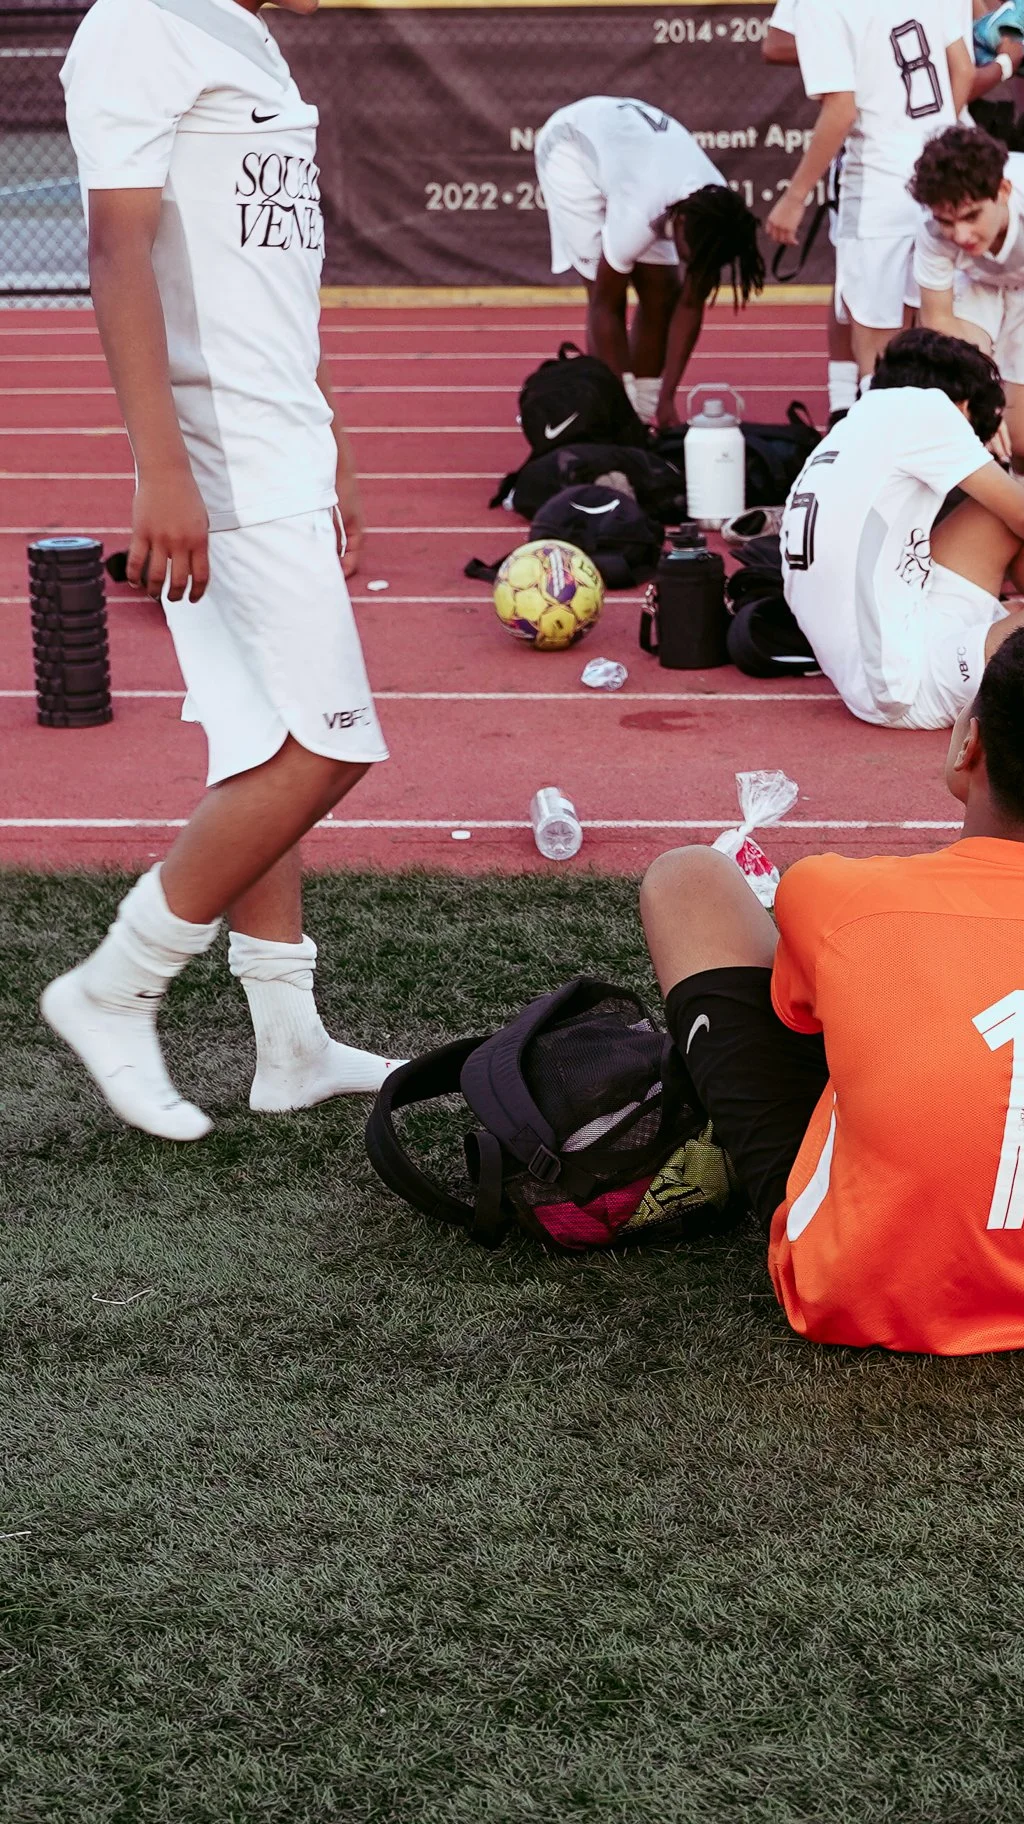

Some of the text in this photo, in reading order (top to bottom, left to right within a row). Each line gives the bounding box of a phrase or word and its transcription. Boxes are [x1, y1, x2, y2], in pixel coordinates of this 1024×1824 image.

[653, 18, 713, 43] 2014
[890, 19, 943, 118] 8
[697, 123, 816, 154] ment App
[425, 182, 548, 210] 2022 20
[236, 203, 321, 250] VENE
